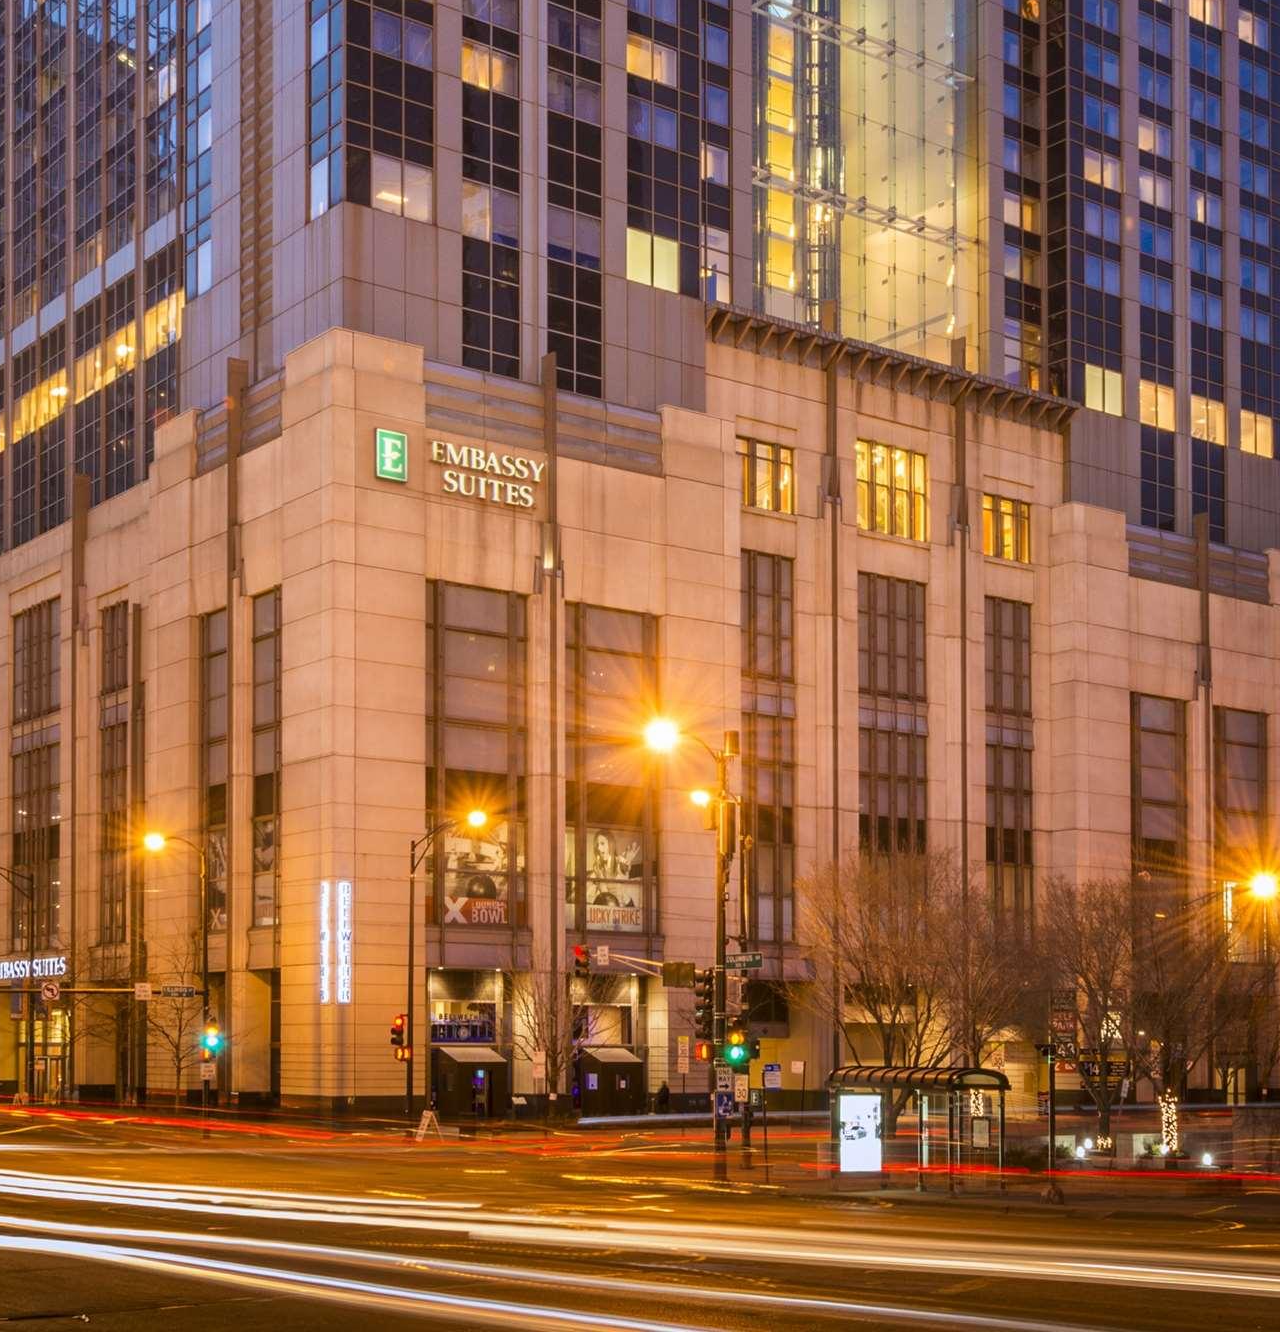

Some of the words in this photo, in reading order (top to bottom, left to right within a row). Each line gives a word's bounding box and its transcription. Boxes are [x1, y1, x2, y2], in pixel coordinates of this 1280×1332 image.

[432, 440, 545, 483] EMBASSY
[443, 470, 534, 507] SUITES
[472, 908, 508, 924] BOWL
[613, 908, 641, 925] STRIKE
[32, 956, 66, 977] SUITES
